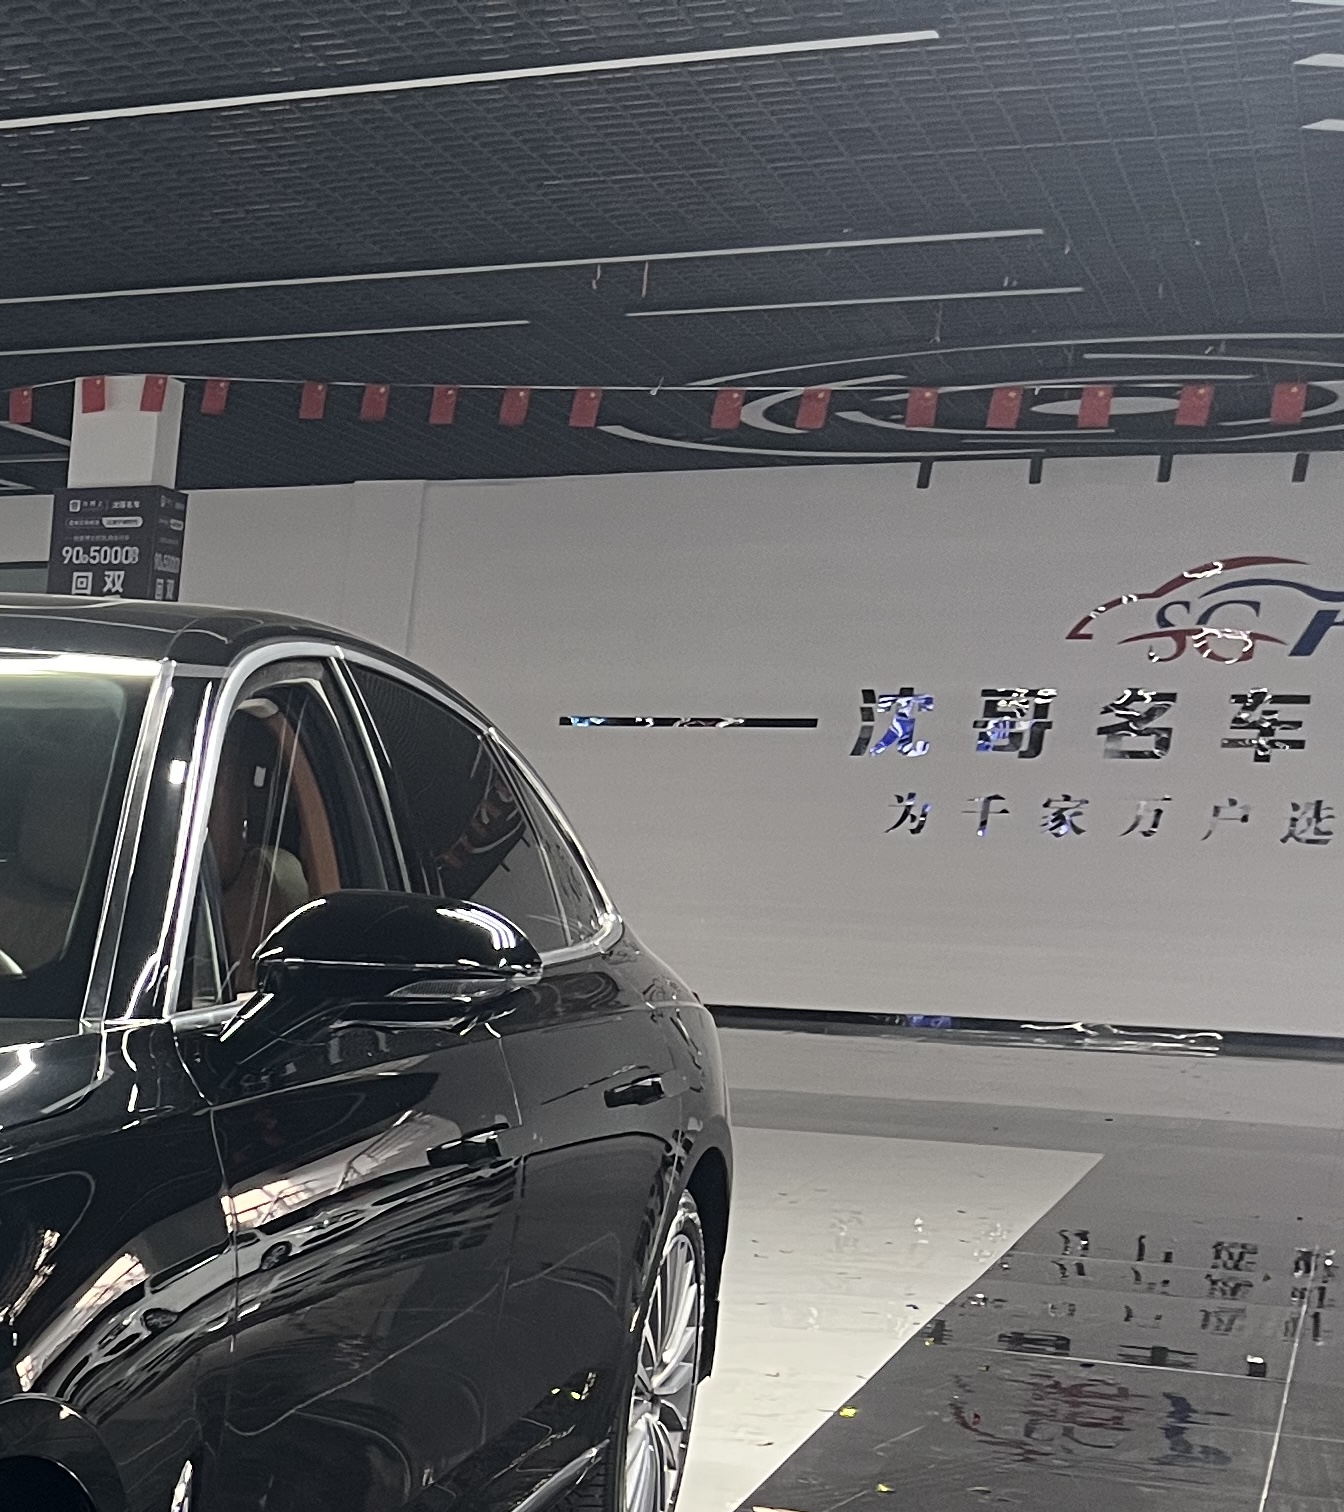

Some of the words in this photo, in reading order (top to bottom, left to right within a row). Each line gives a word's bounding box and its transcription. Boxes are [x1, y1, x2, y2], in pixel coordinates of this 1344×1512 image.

[850, 688, 1311, 763] 沈哥名车
[885, 792, 1334, 846] 为千家万户选
